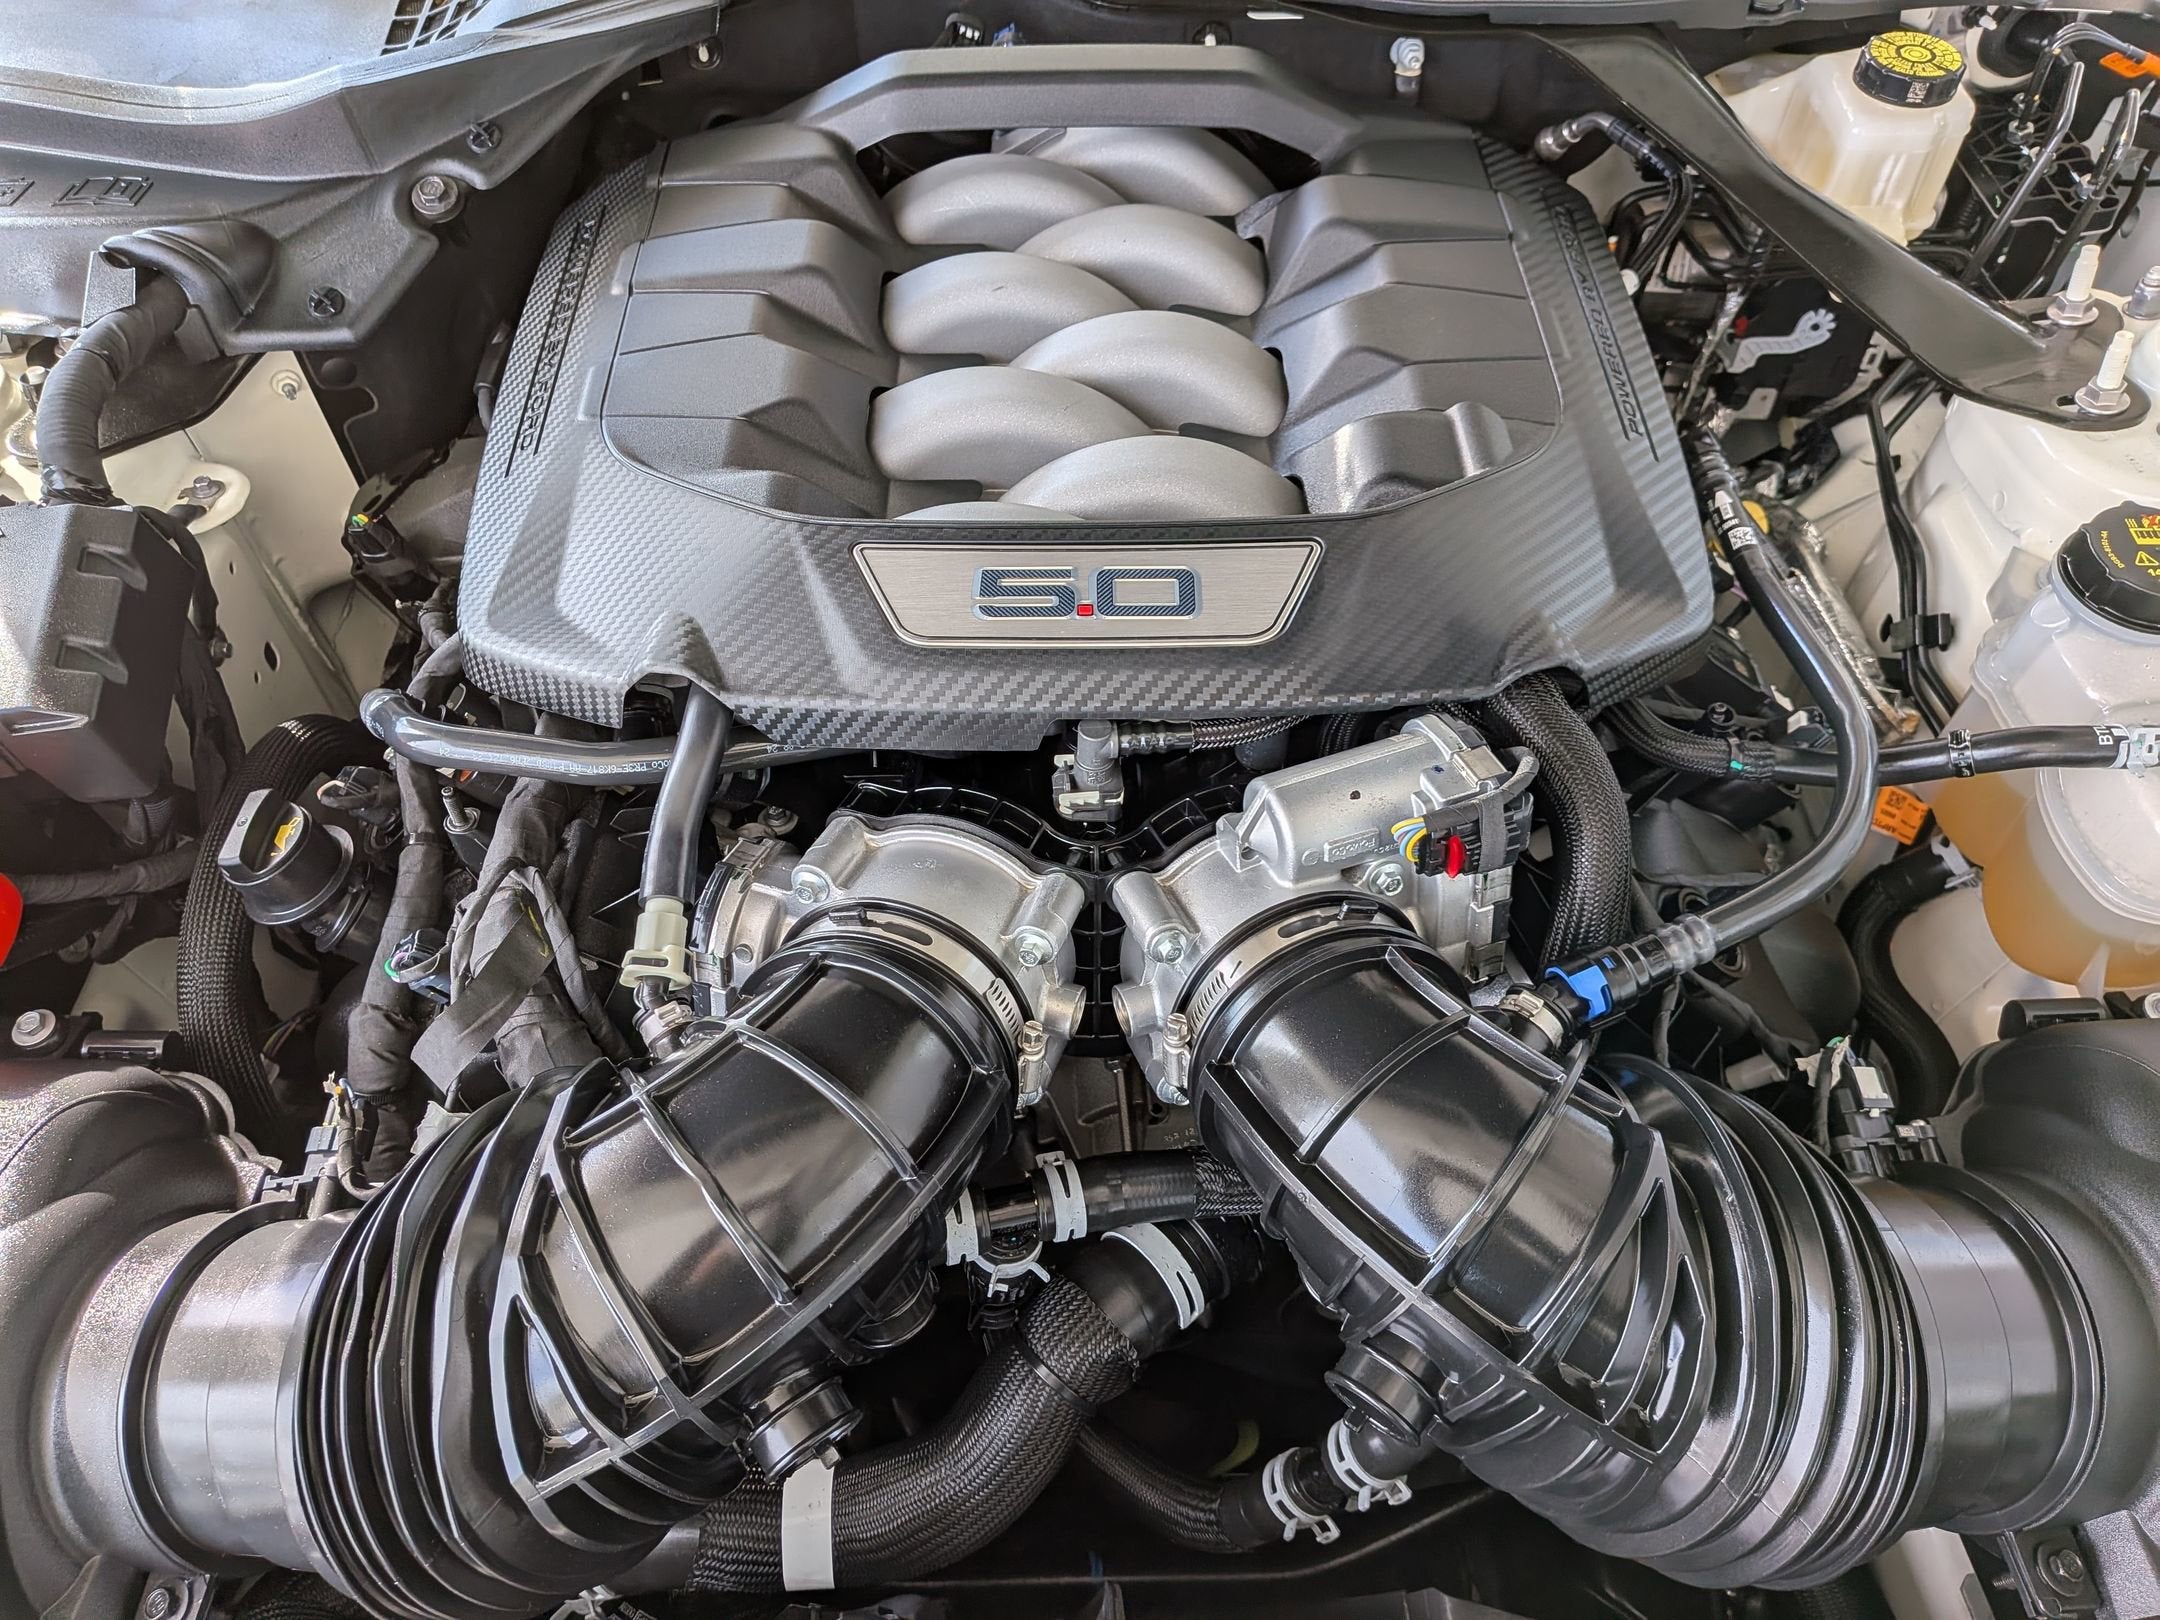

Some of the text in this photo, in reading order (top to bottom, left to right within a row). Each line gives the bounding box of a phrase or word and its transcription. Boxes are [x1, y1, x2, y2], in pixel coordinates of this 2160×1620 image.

[1590, 308, 1644, 438] POWERED
[520, 376, 552, 451] FORD
[971, 565, 1203, 621] 5.0
